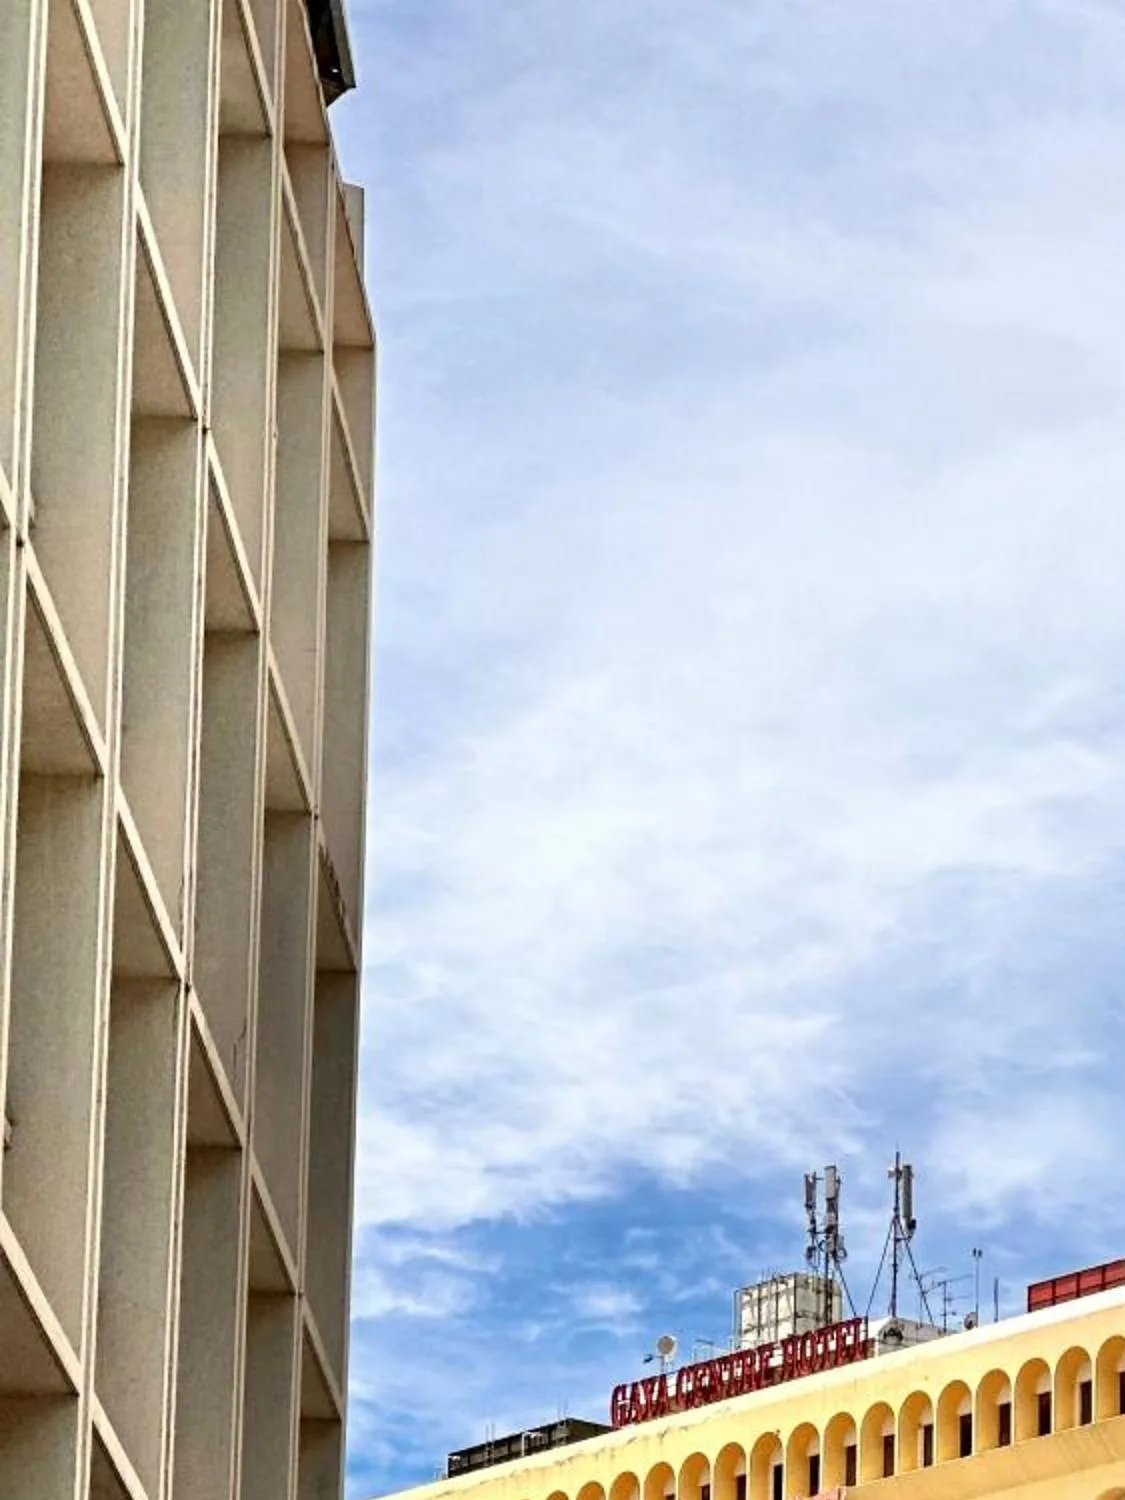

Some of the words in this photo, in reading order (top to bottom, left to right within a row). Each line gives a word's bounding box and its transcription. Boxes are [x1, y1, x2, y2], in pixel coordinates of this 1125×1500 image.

[611, 1374, 670, 1428] GAYA
[676, 1343, 775, 1411] CENTRE
[781, 1317, 868, 1379] HOTEL
